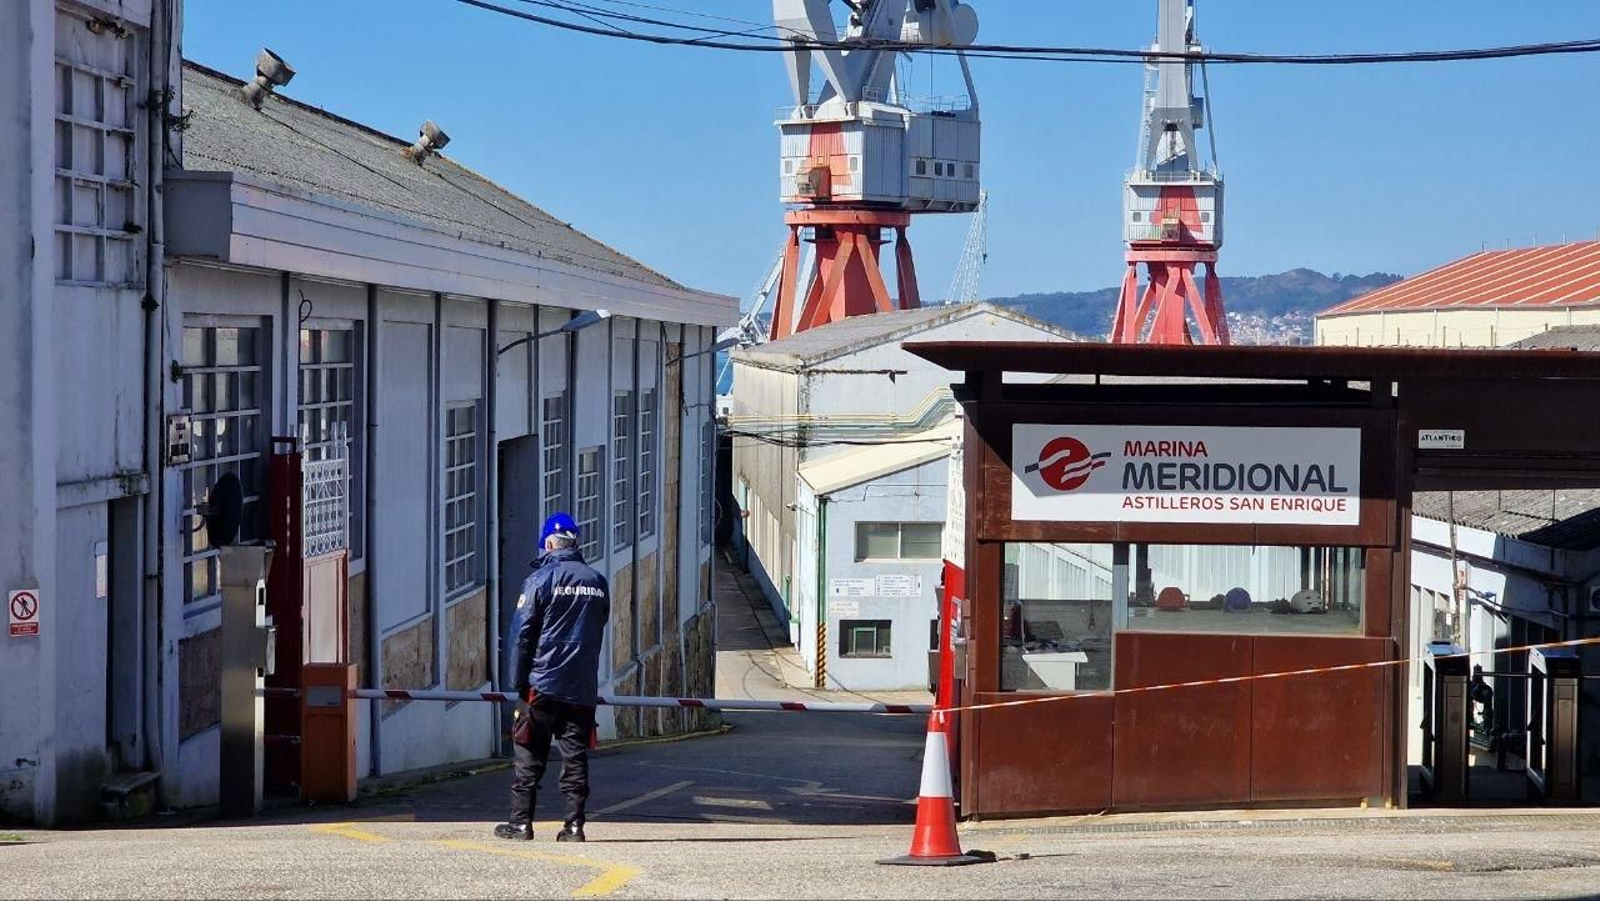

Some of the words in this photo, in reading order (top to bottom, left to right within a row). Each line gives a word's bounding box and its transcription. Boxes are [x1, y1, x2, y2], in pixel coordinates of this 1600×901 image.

[1123, 440, 1208, 457] MARINA
[1121, 462, 1348, 493] MERIDIONAL
[1122, 496, 1225, 511] ASTILLEROS
[1229, 497, 1264, 511] SAN
[1270, 498, 1347, 513] ENRIQUE
